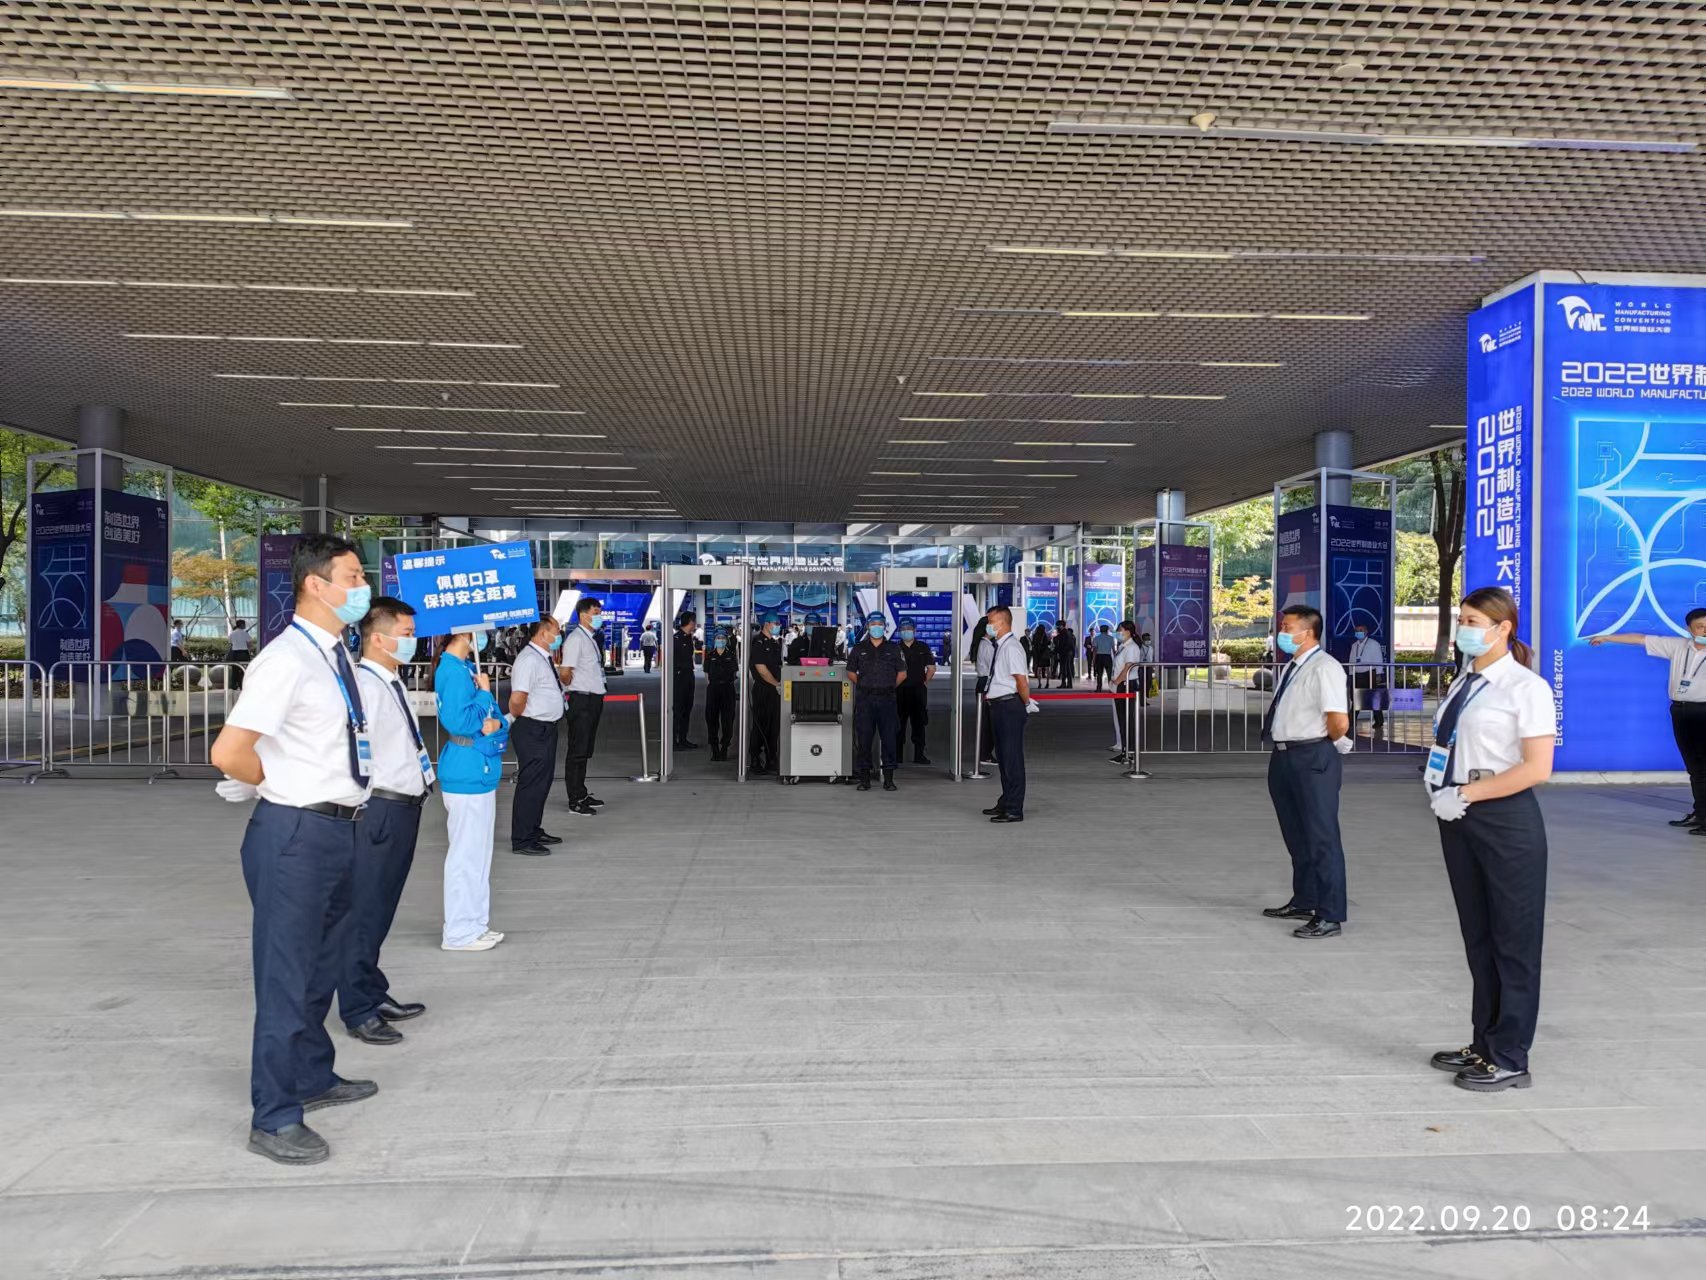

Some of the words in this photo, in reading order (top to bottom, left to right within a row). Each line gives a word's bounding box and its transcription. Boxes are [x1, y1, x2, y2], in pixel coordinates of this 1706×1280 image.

[1615, 309, 1671, 317] MANUFACTURING
[1561, 387, 1593, 397] 2022
[1596, 387, 1634, 398] WORLD
[1476, 414, 1496, 538] 2022
[1496, 407, 1515, 594] 世界制造业大
[437, 570, 499, 590] 佩戴口罩
[424, 585, 517, 609] 保持安全距离
